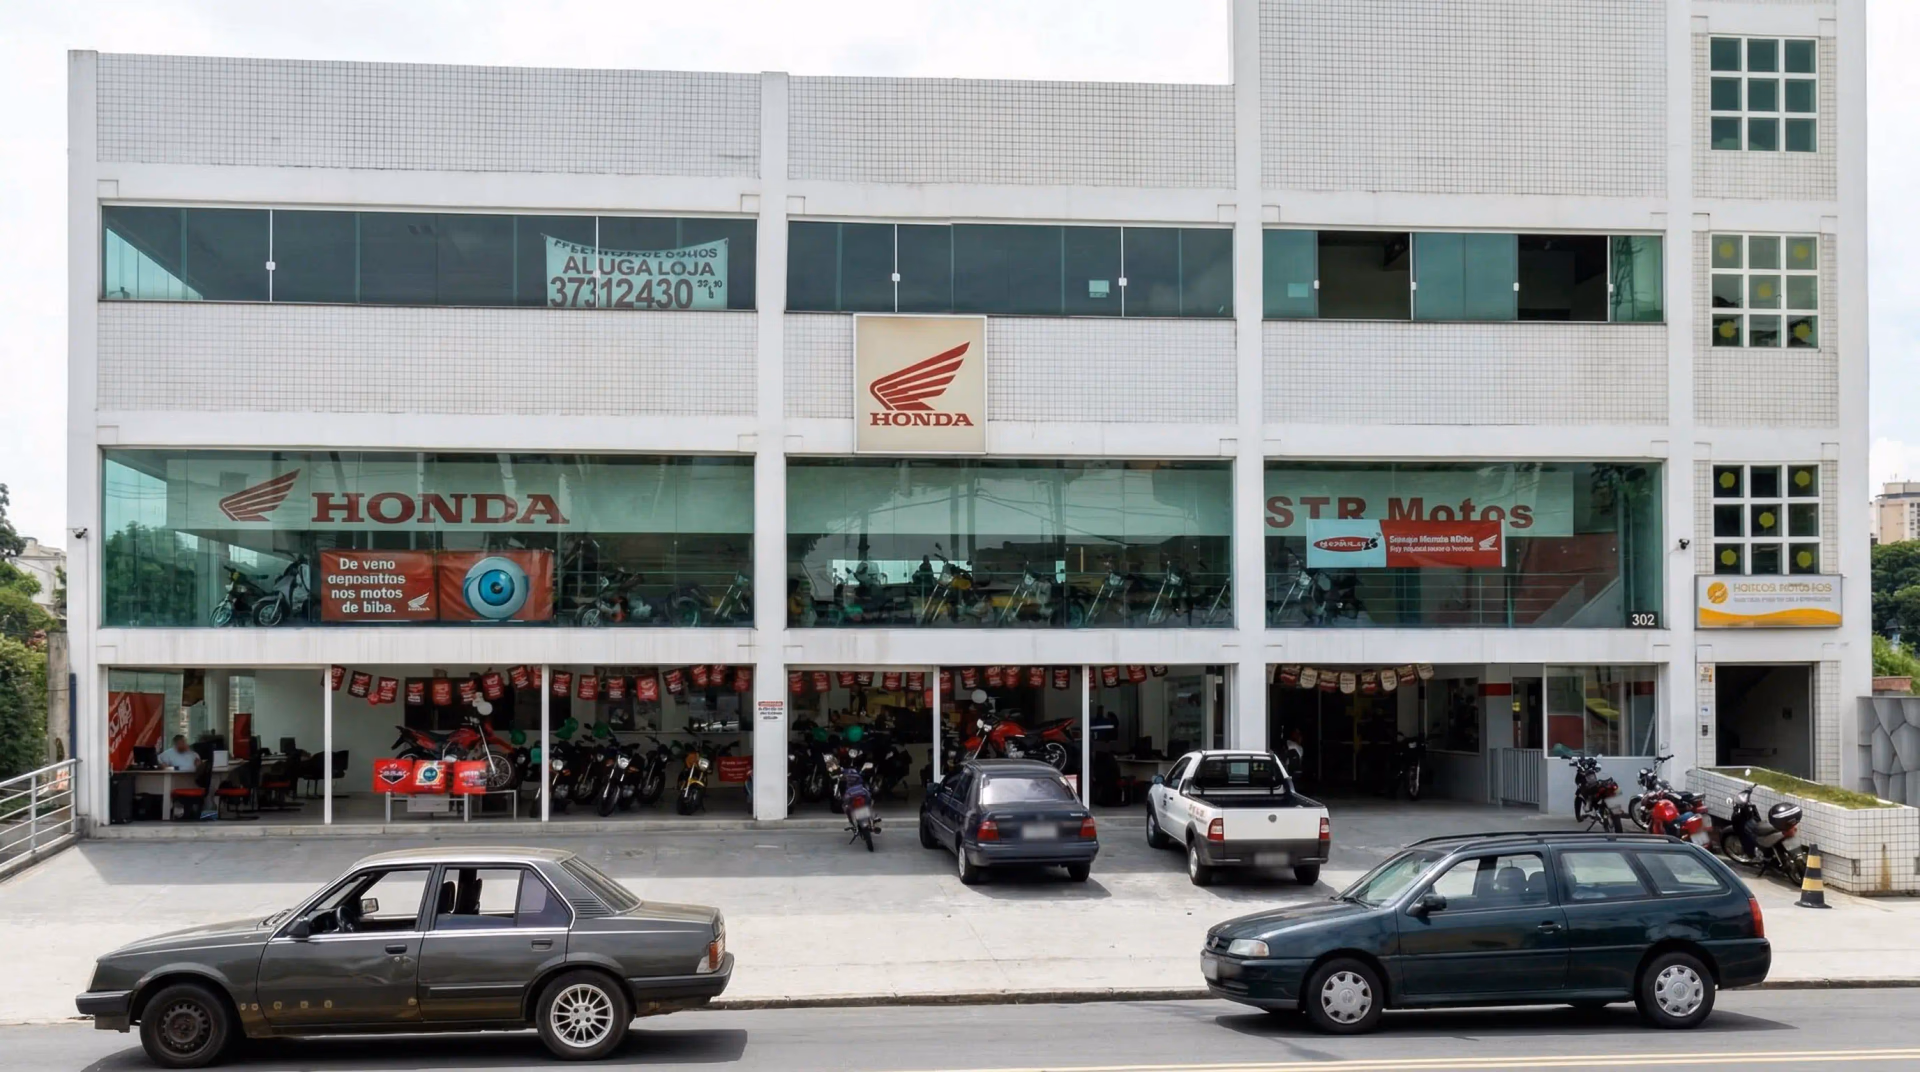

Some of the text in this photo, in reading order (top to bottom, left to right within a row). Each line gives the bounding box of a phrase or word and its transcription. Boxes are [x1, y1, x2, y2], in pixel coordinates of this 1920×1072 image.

[562, 255, 716, 277] ALUGA LOJA
[550, 276, 694, 309] 37312430
[869, 412, 975, 427] HONDA
[311, 492, 571, 525] HONDA
[1265, 495, 1534, 529] STR Motos
[339, 557, 359, 570] De
[331, 586, 403, 599] nos motos
[341, 600, 359, 613] de
[1631, 613, 1655, 626] 302
